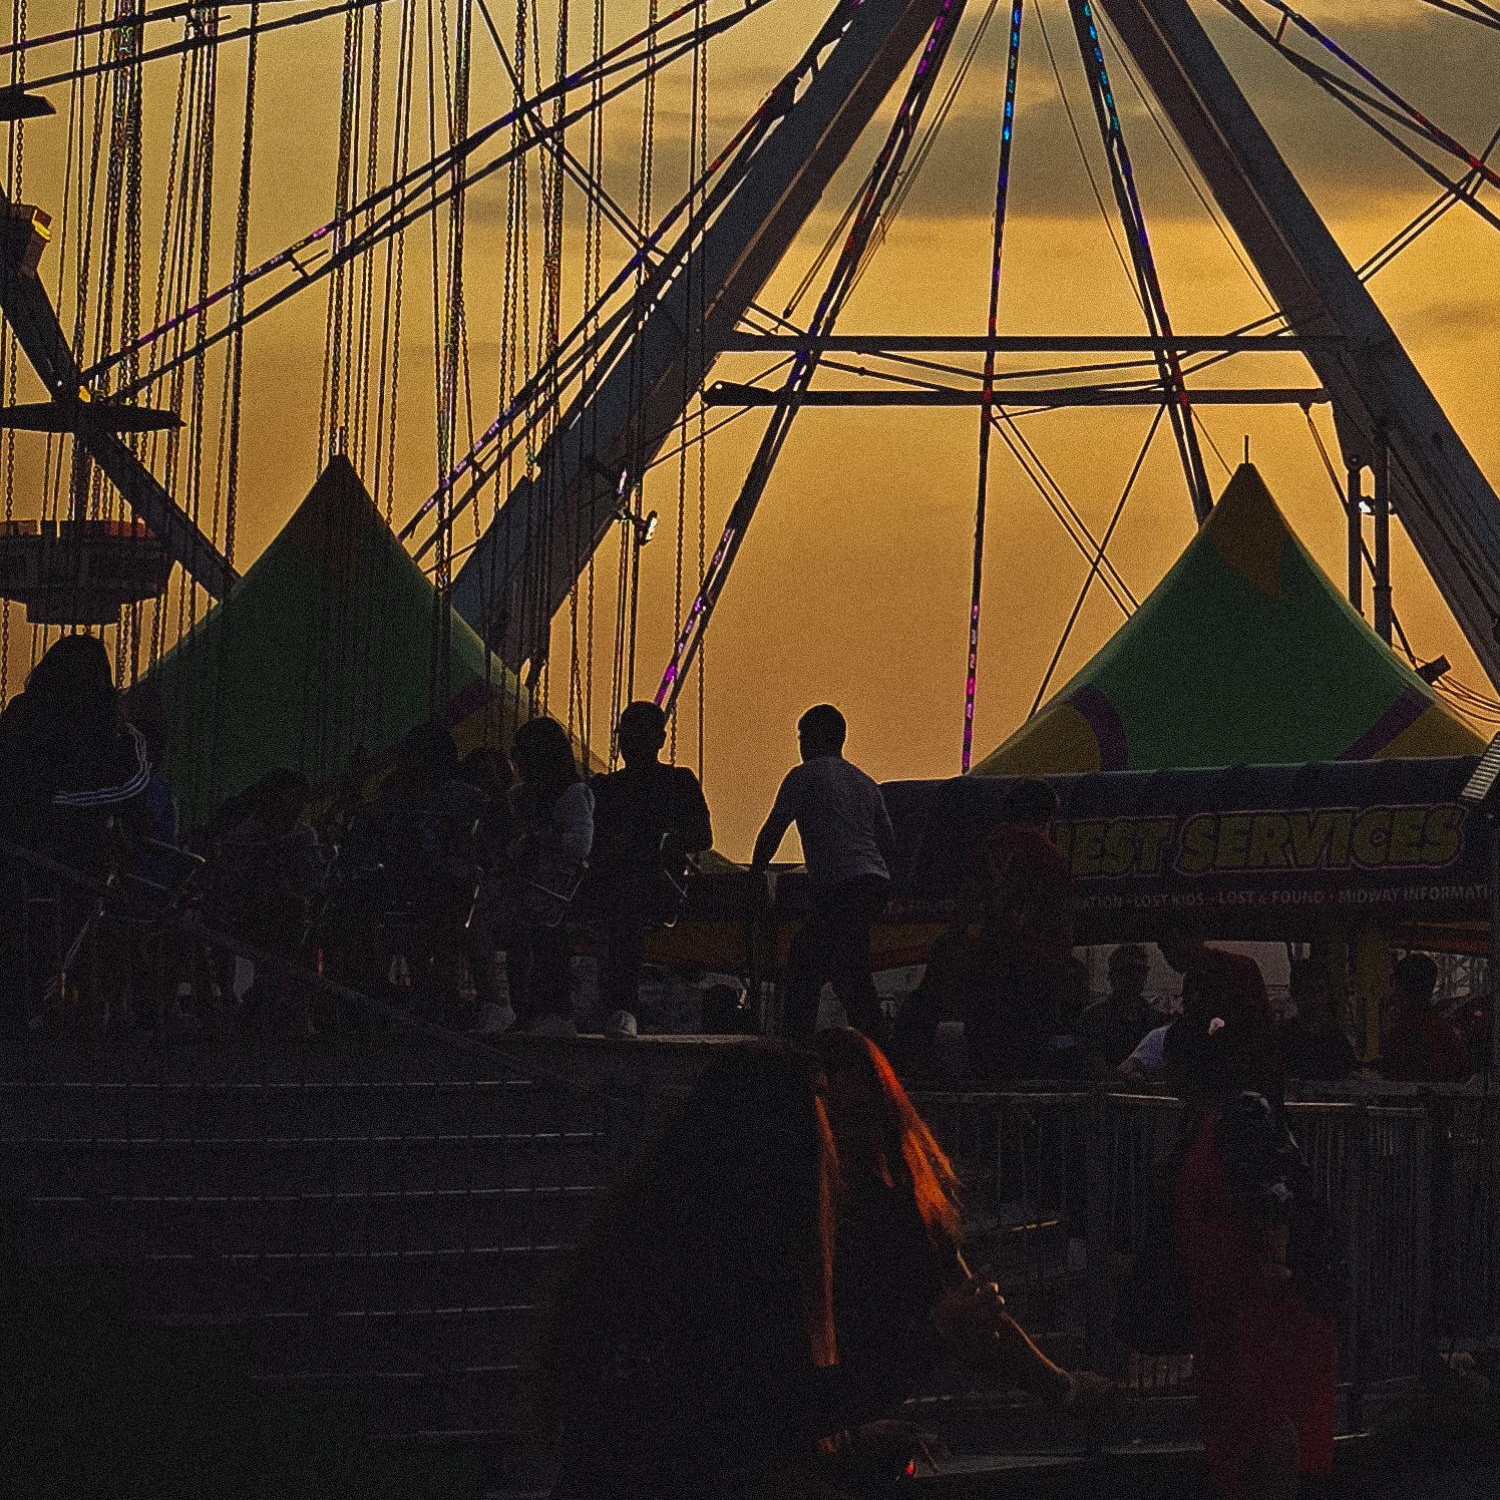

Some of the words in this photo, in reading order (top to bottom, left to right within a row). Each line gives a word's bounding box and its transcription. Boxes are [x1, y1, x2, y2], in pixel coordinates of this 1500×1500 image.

[1176, 804, 1467, 876] SERVICES
[1217, 890, 1255, 905] LOST
[1271, 889, 1325, 905] FOUND
